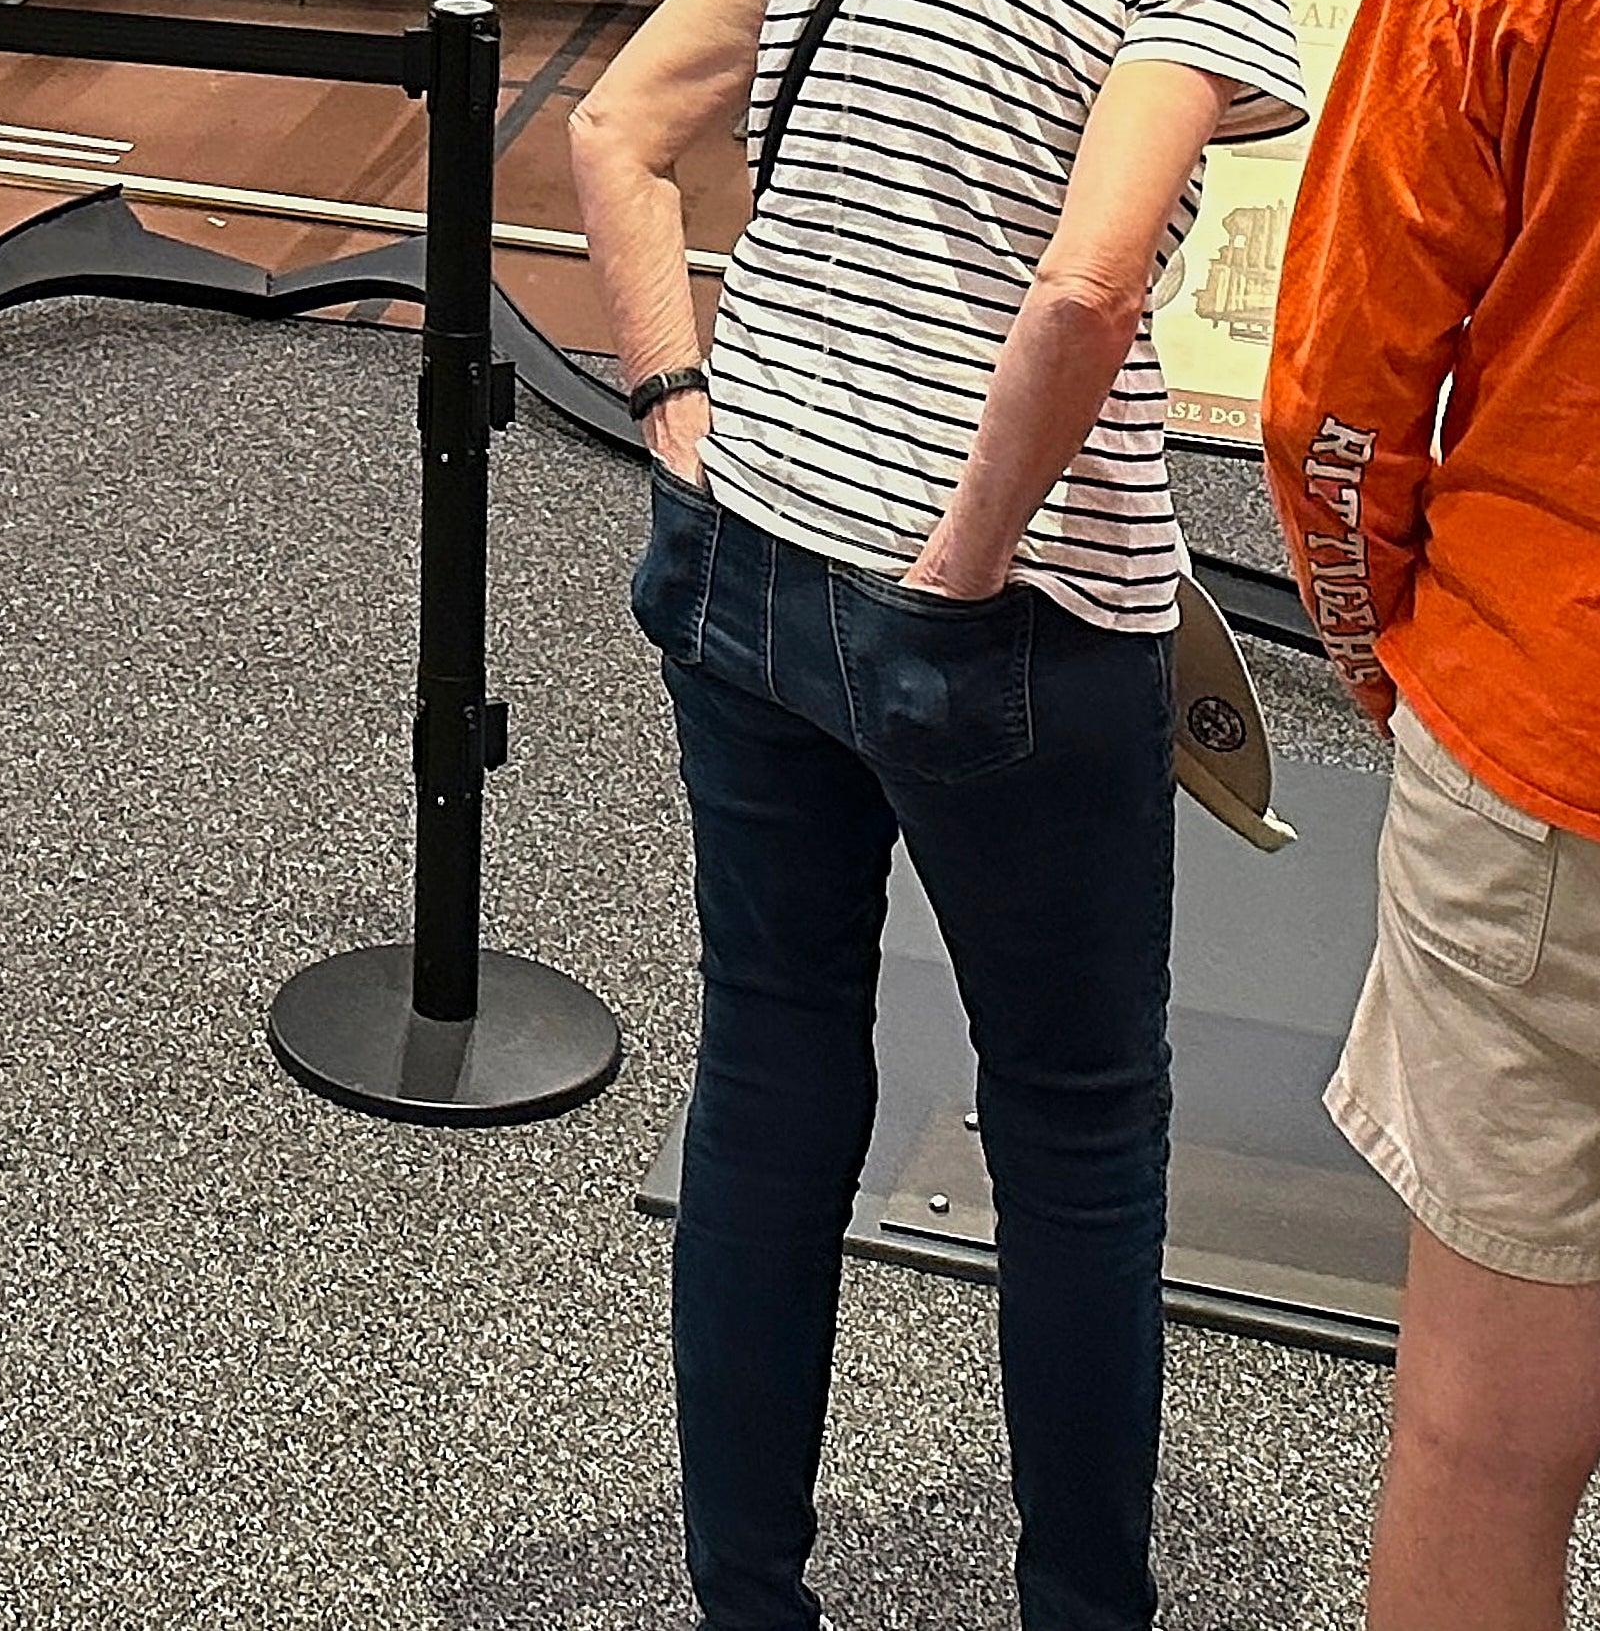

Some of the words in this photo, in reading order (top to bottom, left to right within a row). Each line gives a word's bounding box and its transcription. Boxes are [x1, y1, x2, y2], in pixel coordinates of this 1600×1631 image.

[1209, 407, 1247, 427] DO
[1304, 415, 1378, 528] RIT
[1306, 529, 1384, 685] TIGERS
